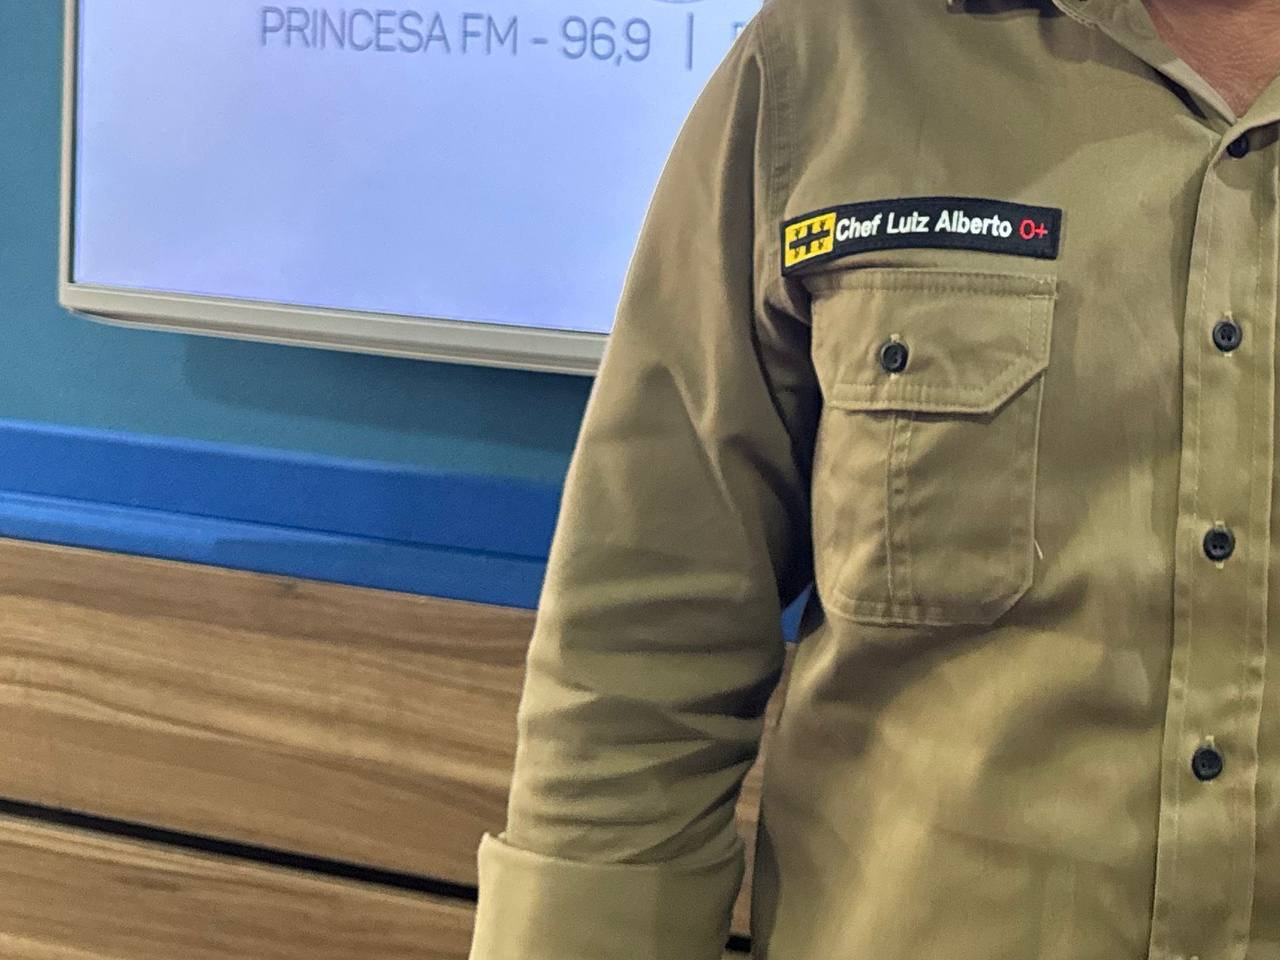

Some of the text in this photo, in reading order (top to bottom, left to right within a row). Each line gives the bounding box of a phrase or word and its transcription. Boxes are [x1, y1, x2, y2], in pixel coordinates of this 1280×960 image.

[259, 5, 451, 54] PRINCESA
[461, 12, 518, 56] FM
[561, 15, 652, 67] 96,9
[835, 211, 882, 241] Chef
[886, 211, 929, 235] Luiz
[934, 209, 1012, 239] Alberto
